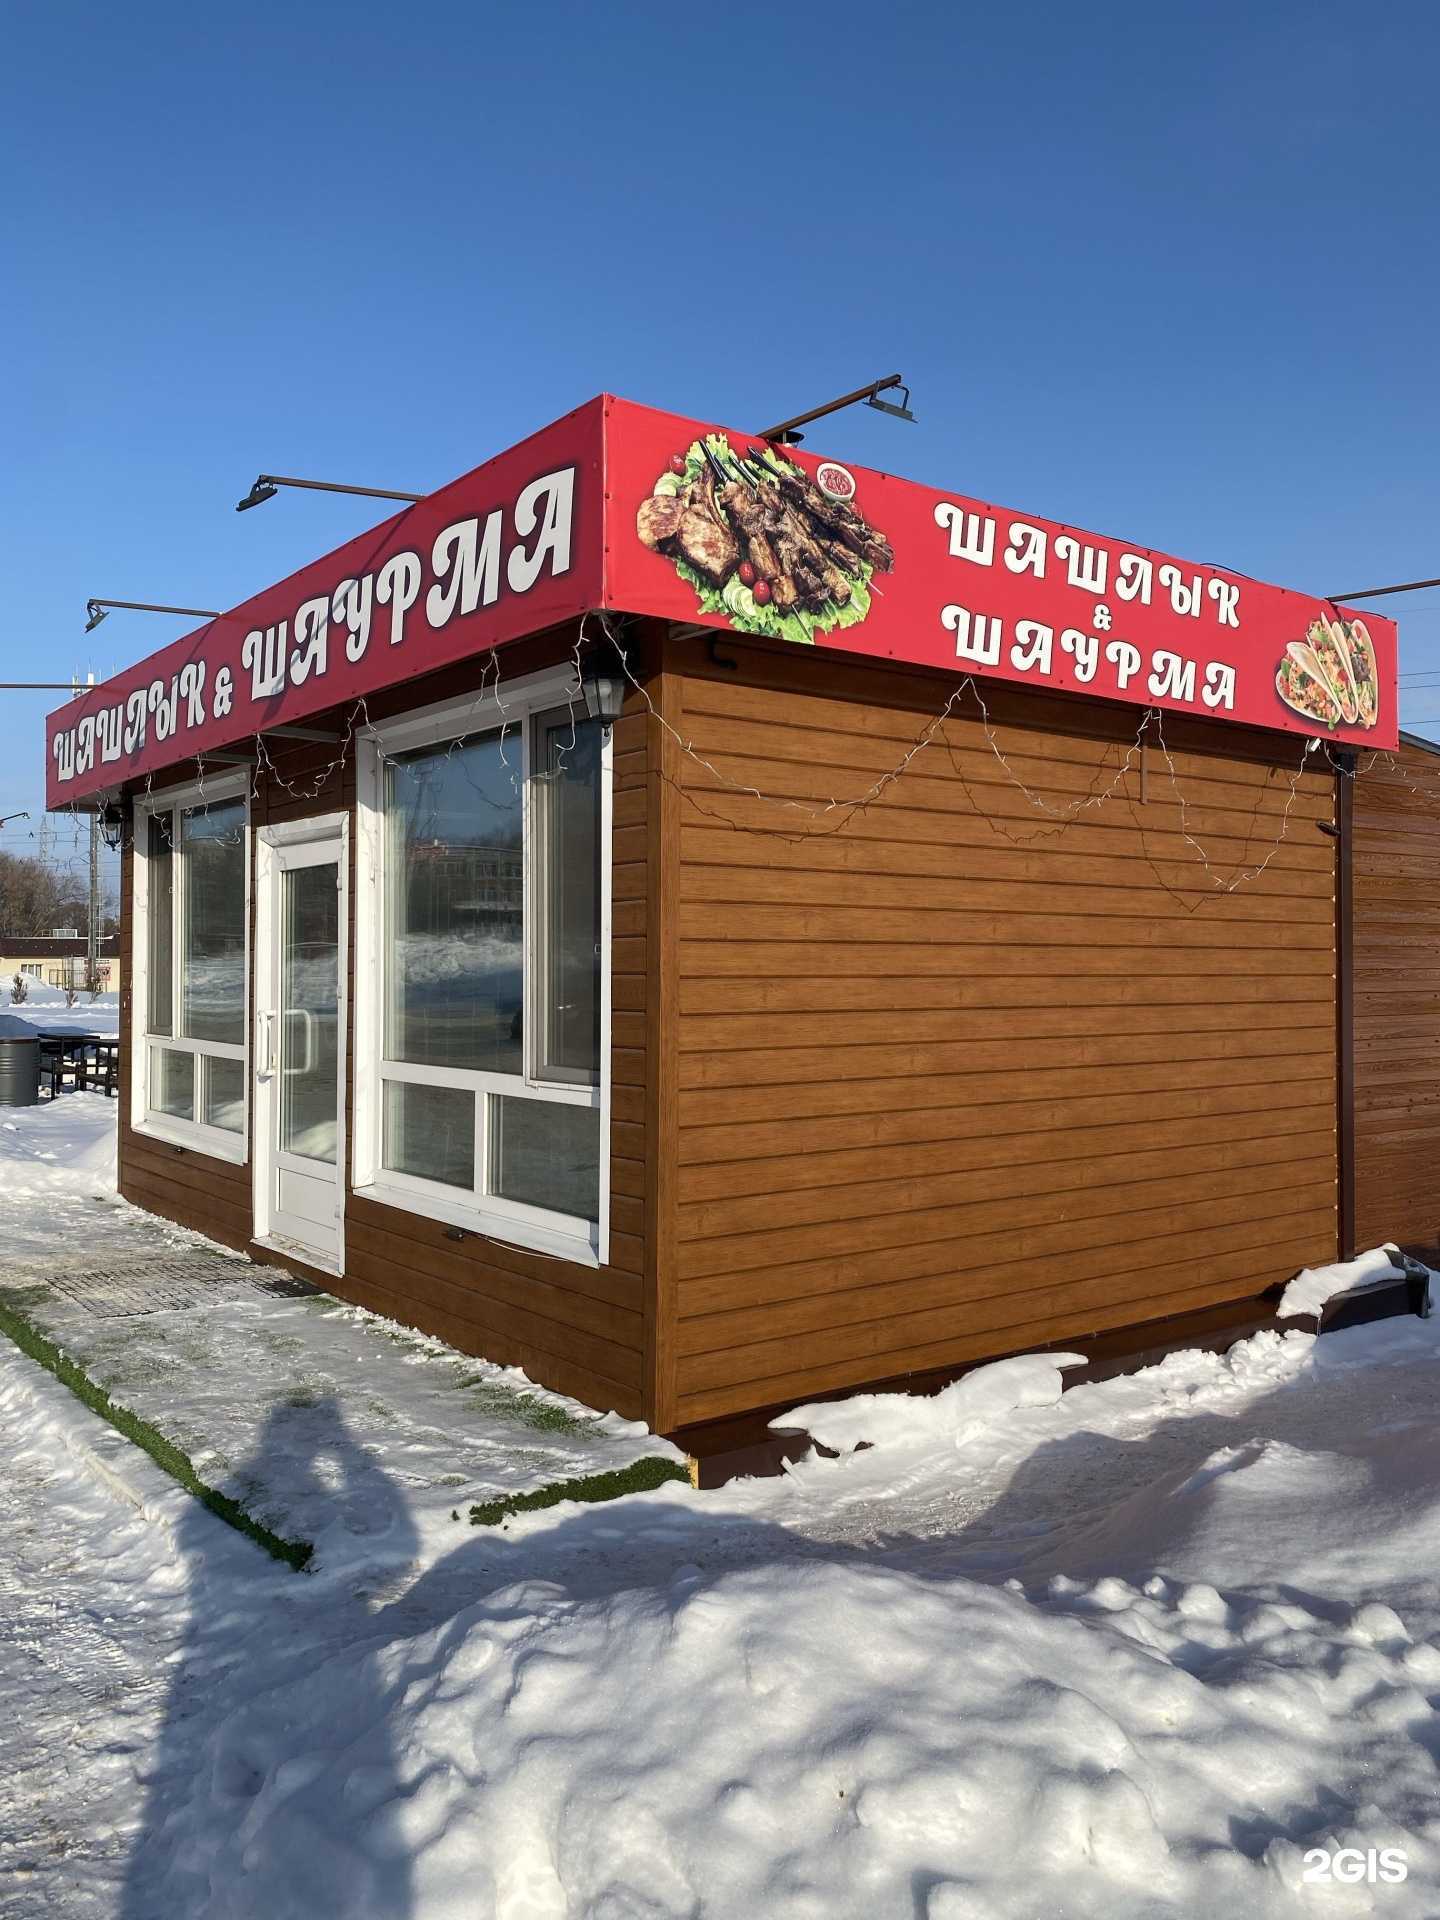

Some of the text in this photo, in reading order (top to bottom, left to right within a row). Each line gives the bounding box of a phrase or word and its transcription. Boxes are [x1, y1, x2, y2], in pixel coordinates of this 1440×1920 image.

[933, 502, 1240, 629] ШАШЛЫК
[1092, 603, 1112, 631] &
[53, 466, 576, 782] ШАШЛЫК & ШАУРМА
[940, 604, 1237, 710] ШАУРМА
